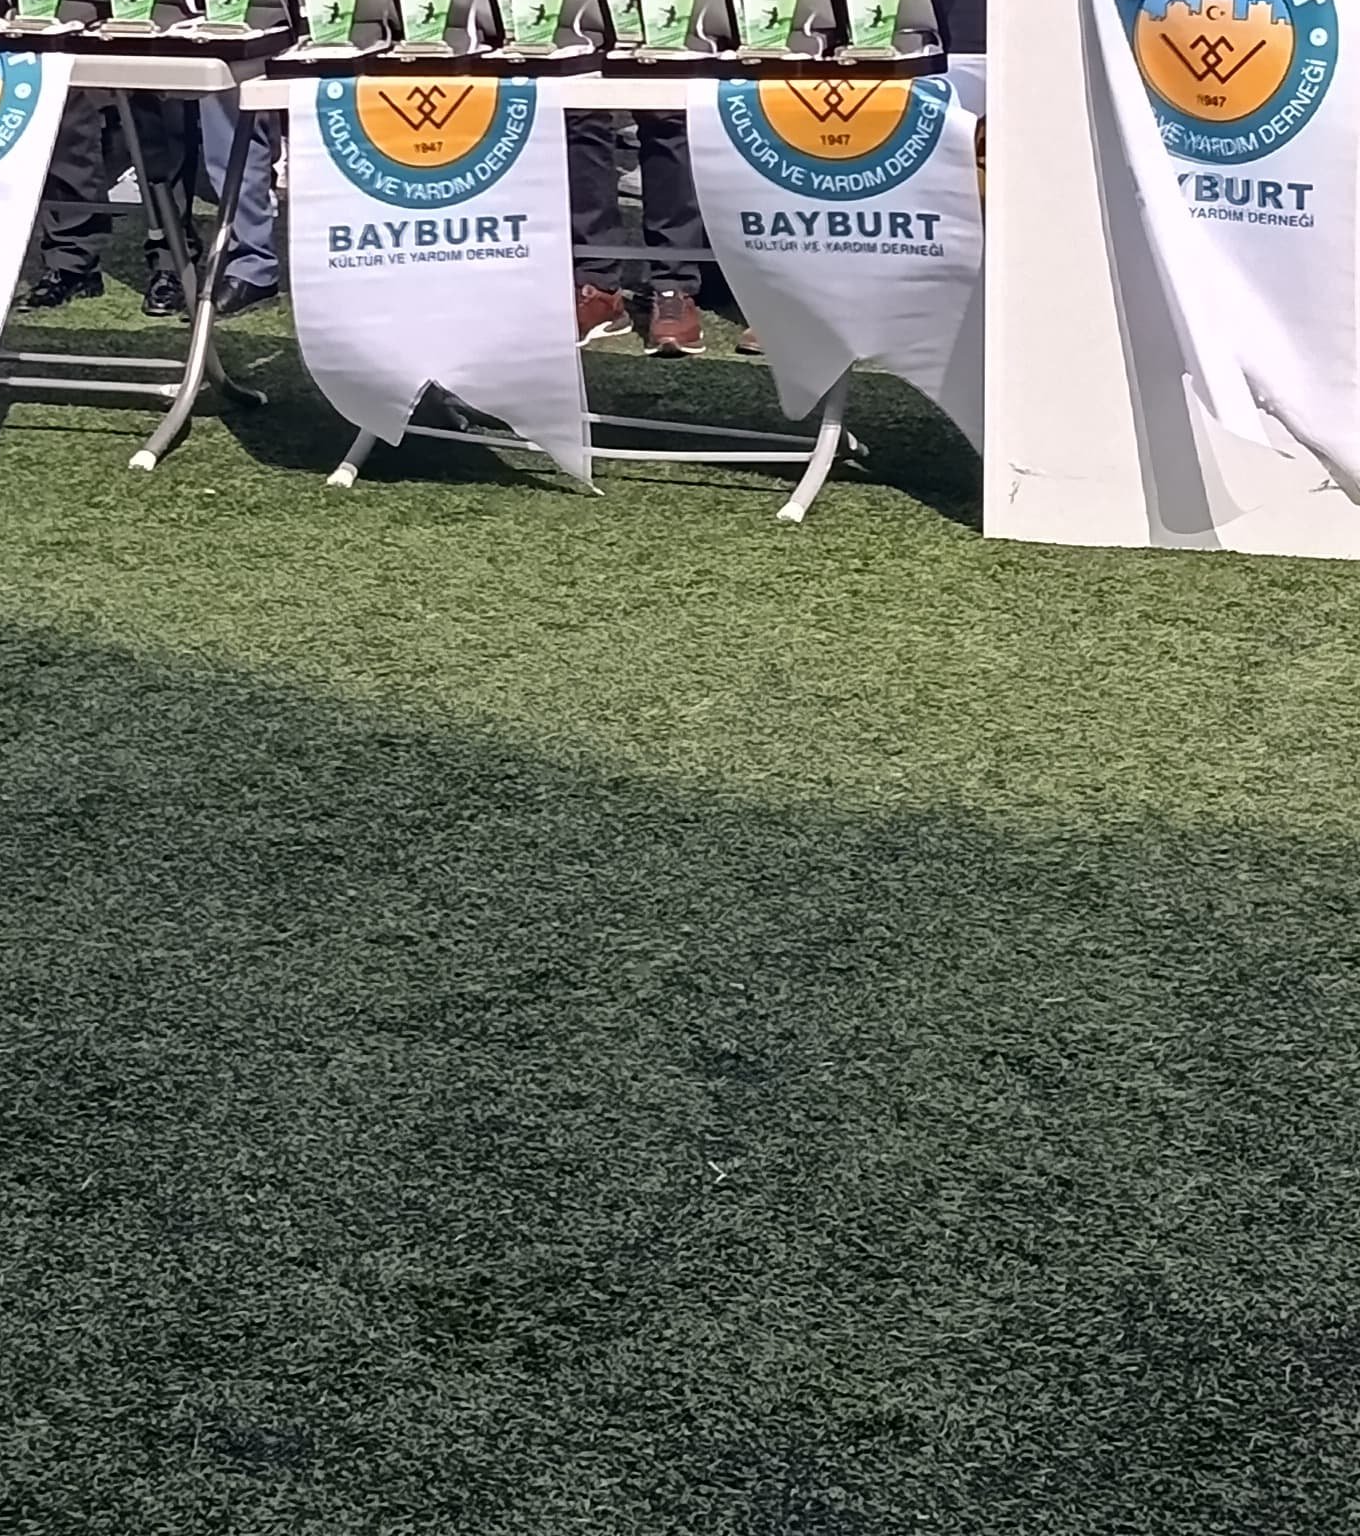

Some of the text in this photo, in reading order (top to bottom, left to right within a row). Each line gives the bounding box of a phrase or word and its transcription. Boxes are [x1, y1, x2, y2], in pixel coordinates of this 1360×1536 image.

[1258, 58, 1328, 145] DERNEĞİ
[327, 97, 529, 201] KÜLTÜR VE YARDIM DERNEĞİ
[414, 141, 444, 154] 1947
[727, 94, 942, 193] KÜLTÜR VE YARDIM DERNEĞİ
[820, 133, 851, 146] 1947
[741, 210, 942, 241] BAYBURT
[1189, 207, 1315, 228] YARDIM DERNEĞİ
[328, 215, 528, 253] BAYBURT
[745, 238, 945, 257] KÜLTÜR VE YARDIM DERNEĞİ
[328, 244, 530, 269] KÜLTÜR VE YARDIM DERNEĞİ
